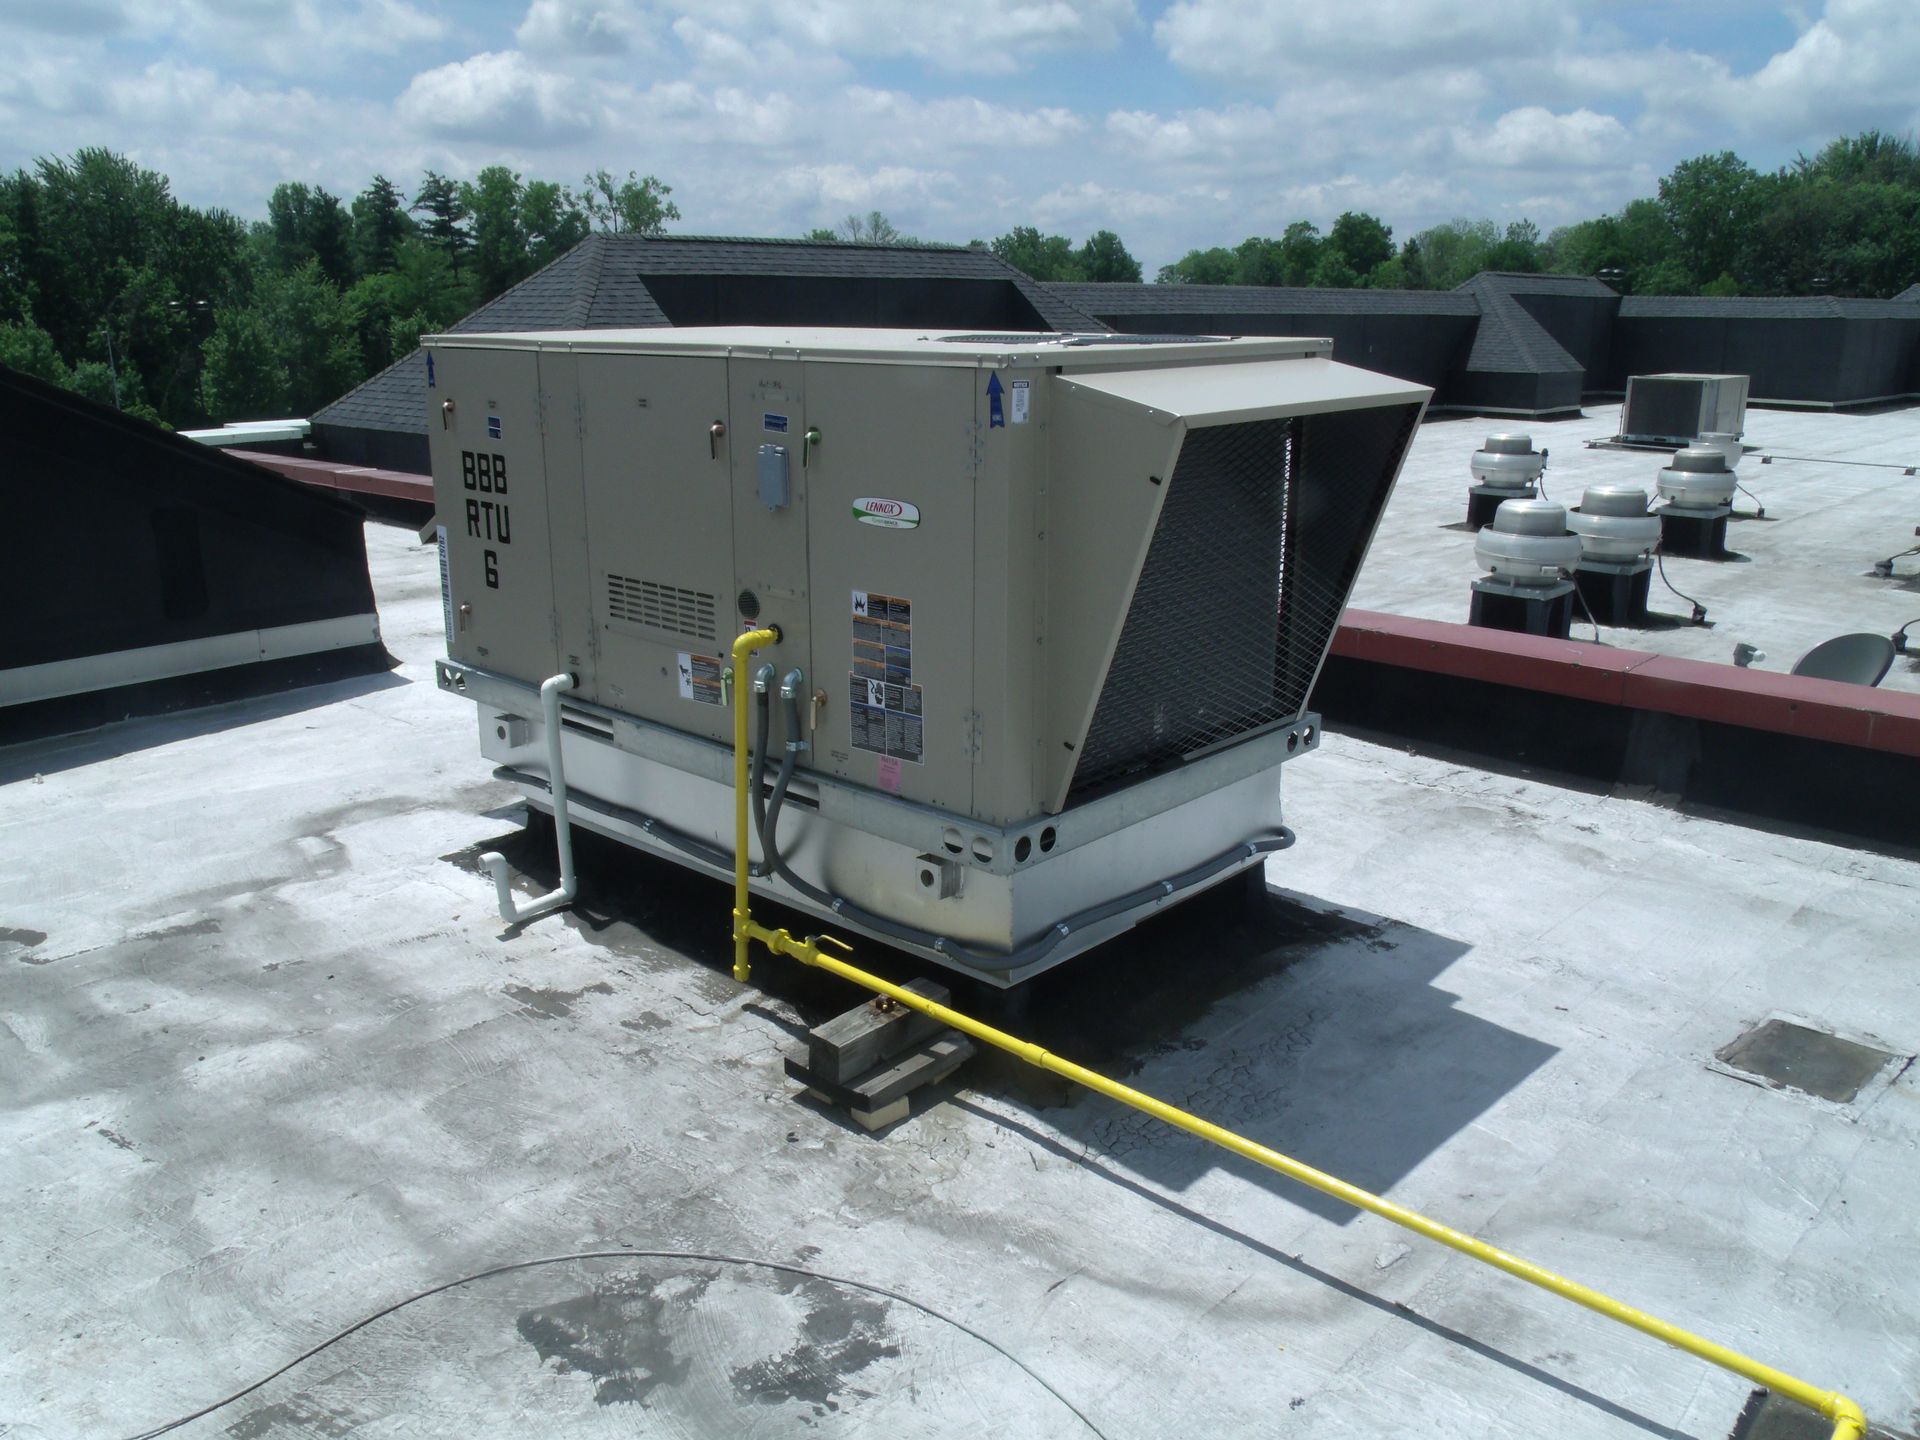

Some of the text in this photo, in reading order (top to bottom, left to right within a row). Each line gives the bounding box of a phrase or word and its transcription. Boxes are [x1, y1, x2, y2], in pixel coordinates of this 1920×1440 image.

[462, 450, 508, 495] BBB
[466, 498, 511, 544] RTU
[865, 501, 896, 515] LENNOX
[484, 549, 499, 589] 6
